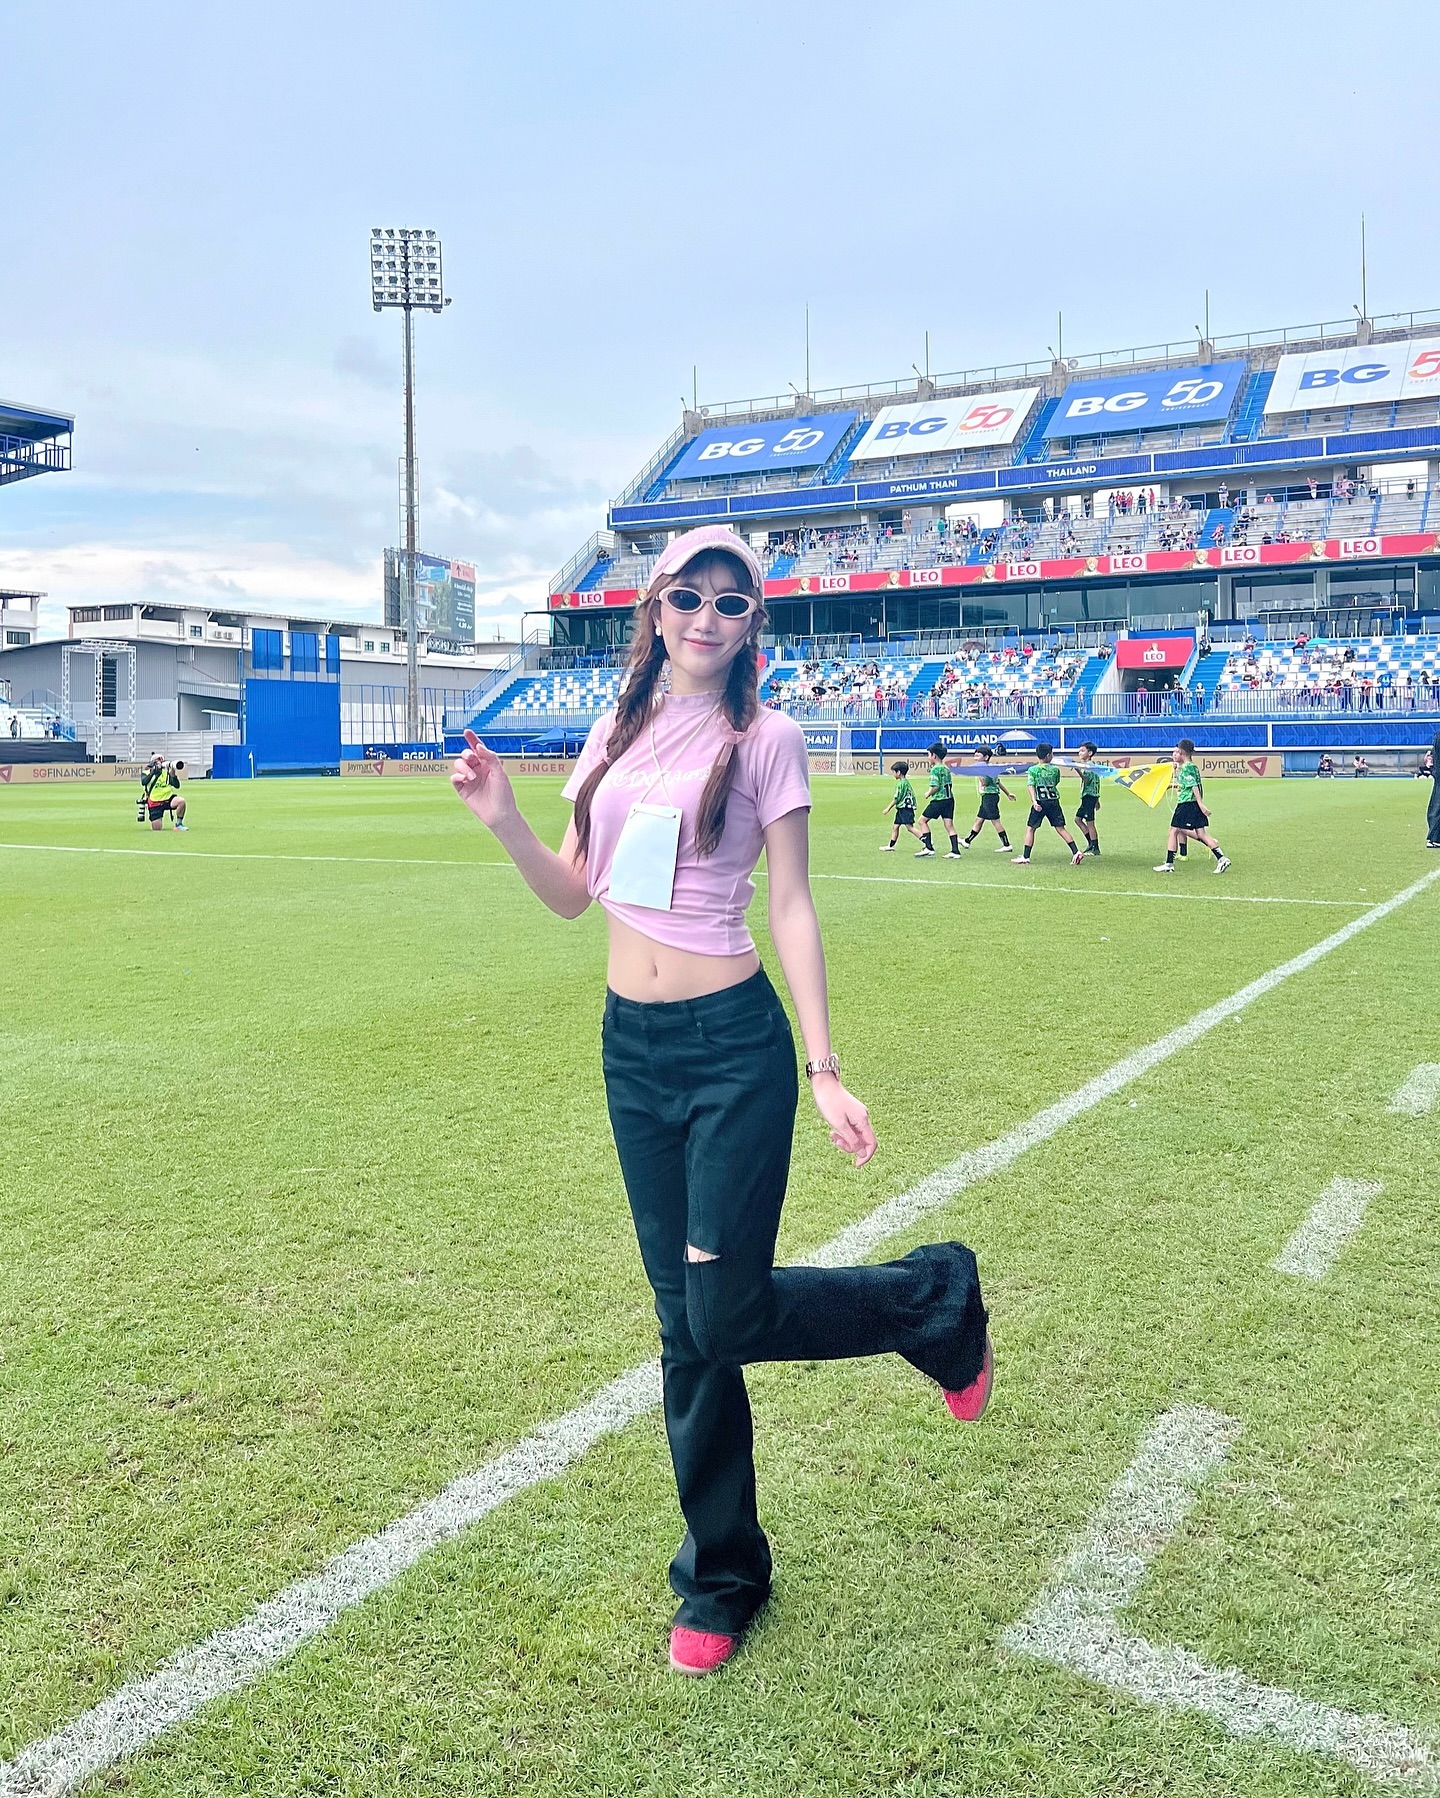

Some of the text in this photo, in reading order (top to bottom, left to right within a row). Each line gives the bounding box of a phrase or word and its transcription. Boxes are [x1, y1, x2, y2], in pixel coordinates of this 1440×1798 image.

[1299, 350, 1440, 390] BG 5
[1065, 378, 1224, 418] BG 50
[874, 404, 1015, 440] BG 50
[697, 427, 825, 461] BG 50
[1046, 465, 1097, 478] THAILAND
[890, 479, 958, 494] PATHUM THANI
[1343, 539, 1378, 554] LEO
[1224, 547, 1257, 562] LEO
[1113, 555, 1143, 569] LEO
[913, 570, 939, 583] LEO
[1010, 564, 1038, 577] LEO
[822, 577, 847, 589] LEO
[581, 593, 602, 604] LEO
[1145, 652, 1163, 661] LEO
[939, 734, 998, 744] THAILAND
[520, 763, 566, 773] SINGER
[1202, 758, 1245, 772] Jaymart
